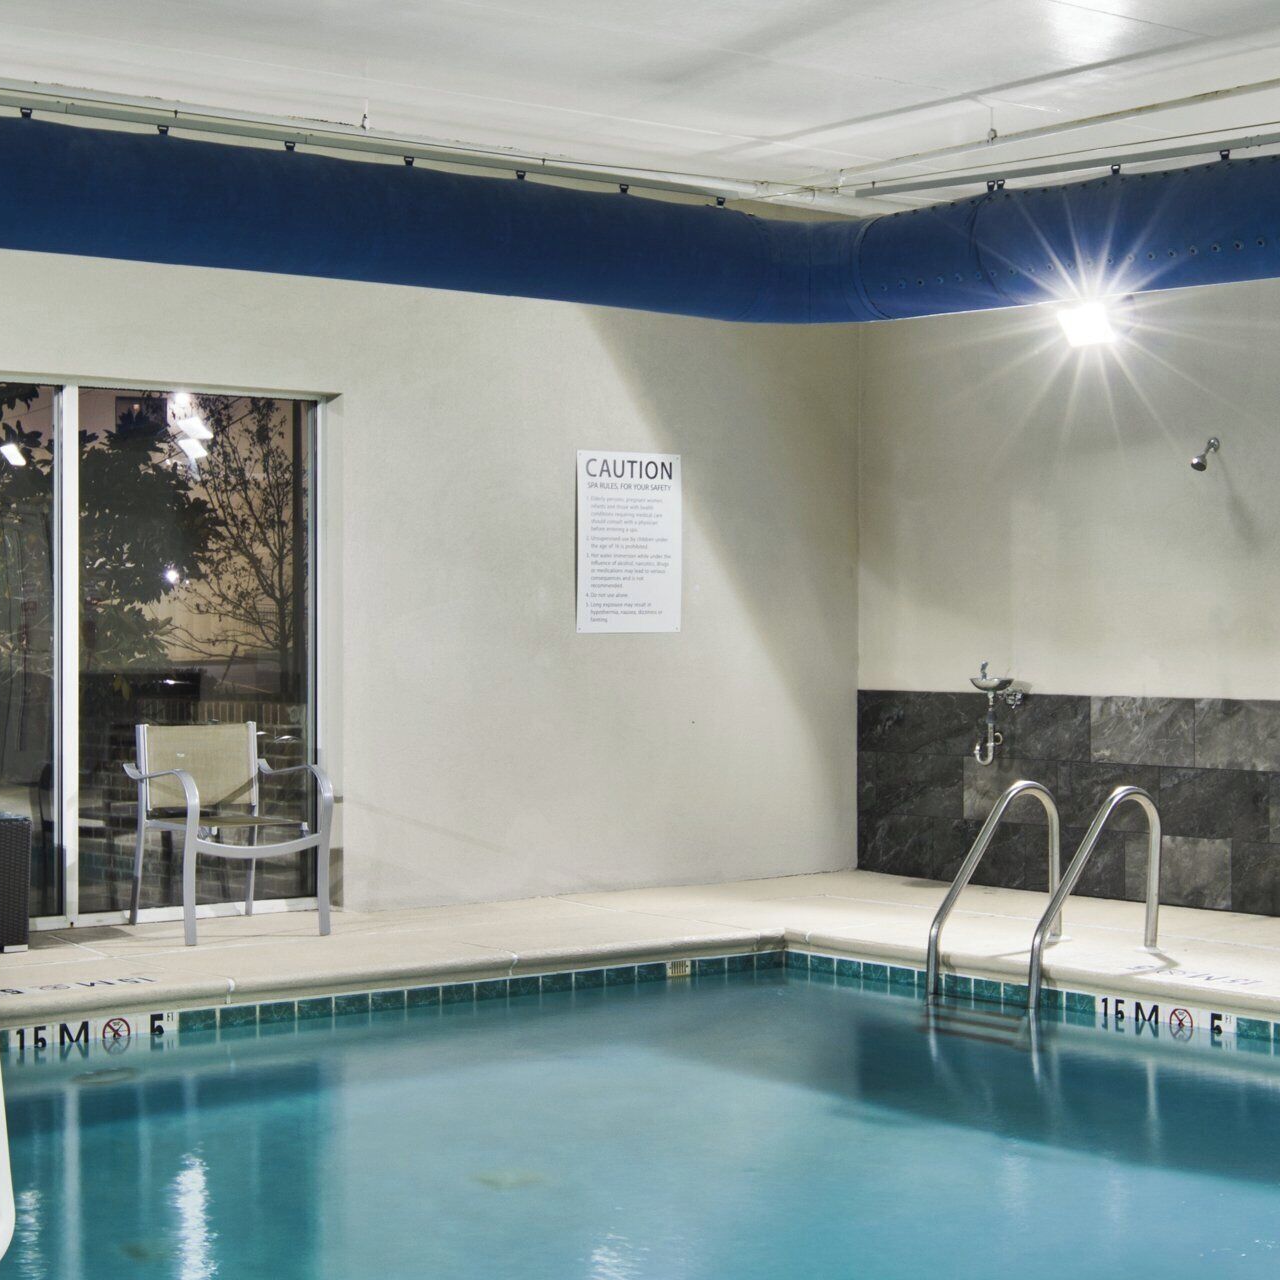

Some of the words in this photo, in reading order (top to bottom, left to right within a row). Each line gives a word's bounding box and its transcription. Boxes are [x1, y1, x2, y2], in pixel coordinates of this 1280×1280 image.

[586, 458, 673, 480] CAUTION
[587, 481, 599, 489] SPA
[634, 483, 650, 491] YOUR
[59, 1020, 90, 1046] M
[150, 1013, 164, 1036] 5
[1135, 1001, 1159, 1026] M
[1210, 1012, 1223, 1036] 5
